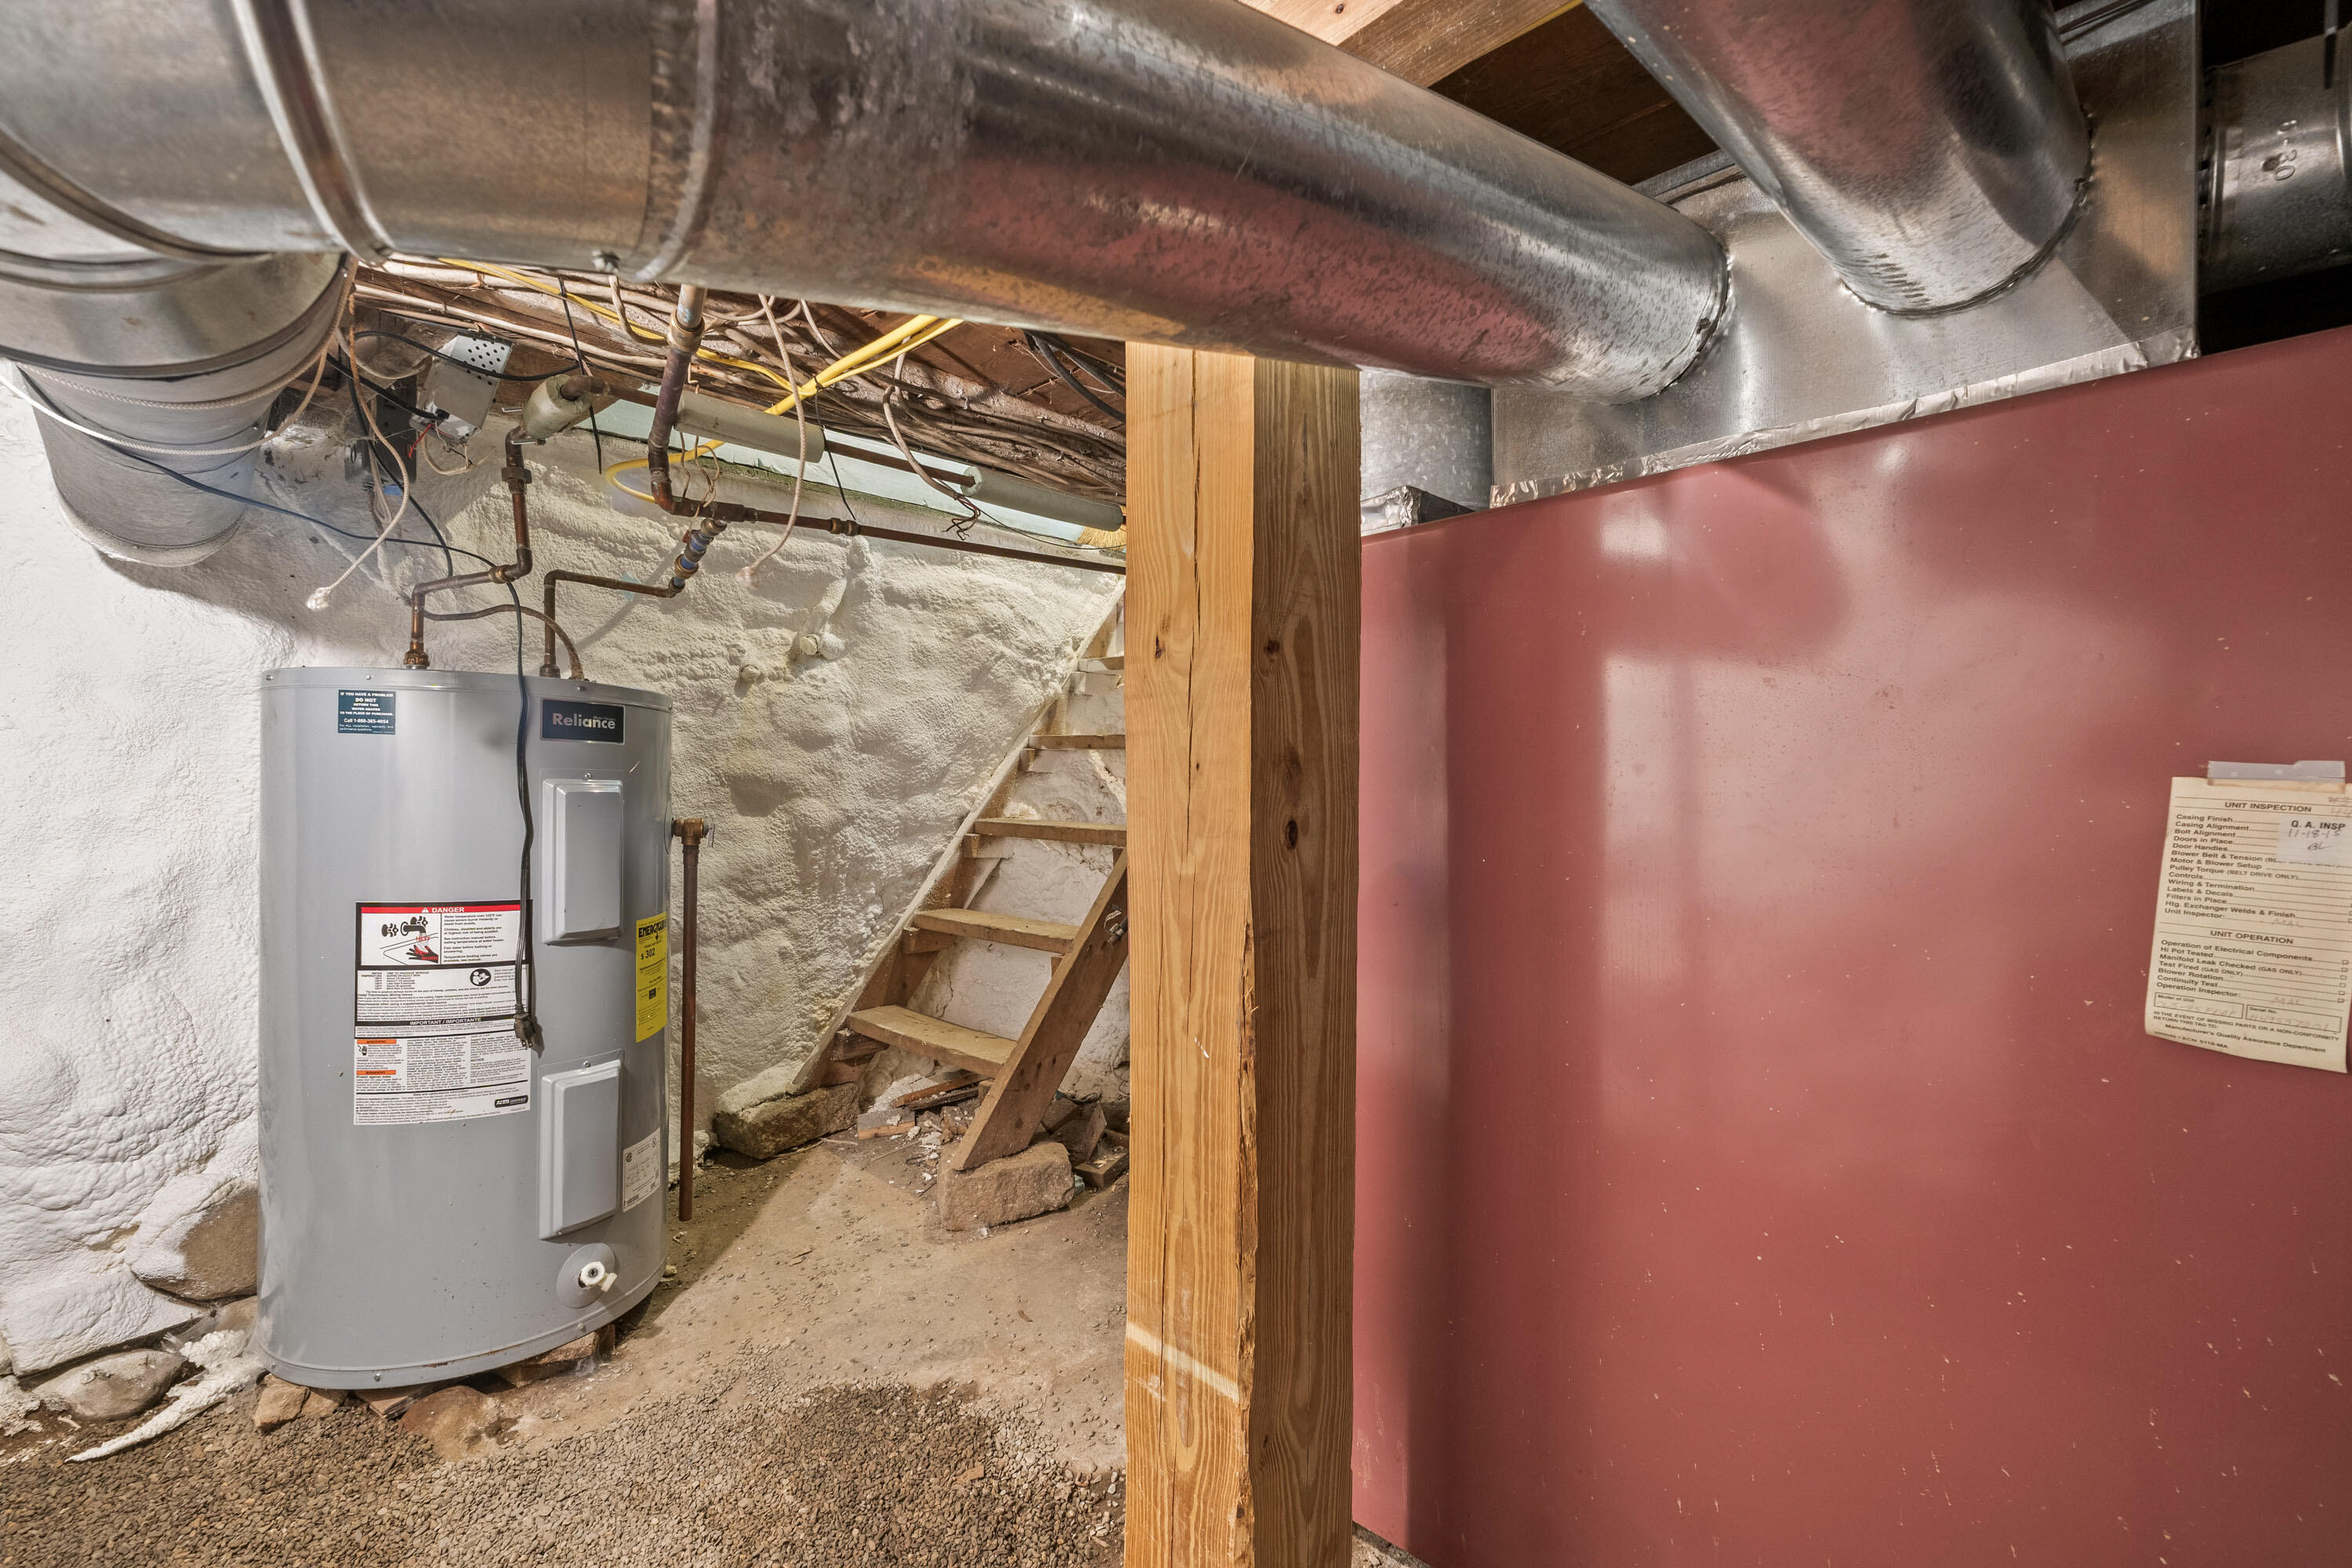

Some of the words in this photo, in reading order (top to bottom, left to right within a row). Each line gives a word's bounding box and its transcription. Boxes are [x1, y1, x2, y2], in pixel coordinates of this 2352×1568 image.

[552, 713, 615, 729] Reliance
[2250, 803, 2312, 812] INSPECTION
[2206, 823, 2249, 832] Alignment
[2193, 830, 2236, 839] Alignment
[2196, 866, 2224, 875] Torque
[2237, 861, 2262, 870] Setup
[2205, 882, 2255, 891] Termination
[2184, 903, 2228, 913] Exchanger
[2235, 932, 2293, 944] OPERATION
[646, 947, 655, 958] 302
[2161, 940, 2201, 950] Operation
[2215, 945, 2254, 955] Electrical
[2257, 950, 2312, 962] Components
[2159, 954, 2194, 963] Manifold
[2219, 960, 2255, 971] Checked
[2158, 968, 2186, 976] Blower
[2189, 971, 2224, 981] Rotation
[2157, 975, 2198, 985] Continuity
[2157, 982, 2196, 992] Operation
[2216, 1032, 2241, 1041] Quality
[2243, 1036, 2281, 1047] Assurance
[2283, 1041, 2326, 1053] Department
